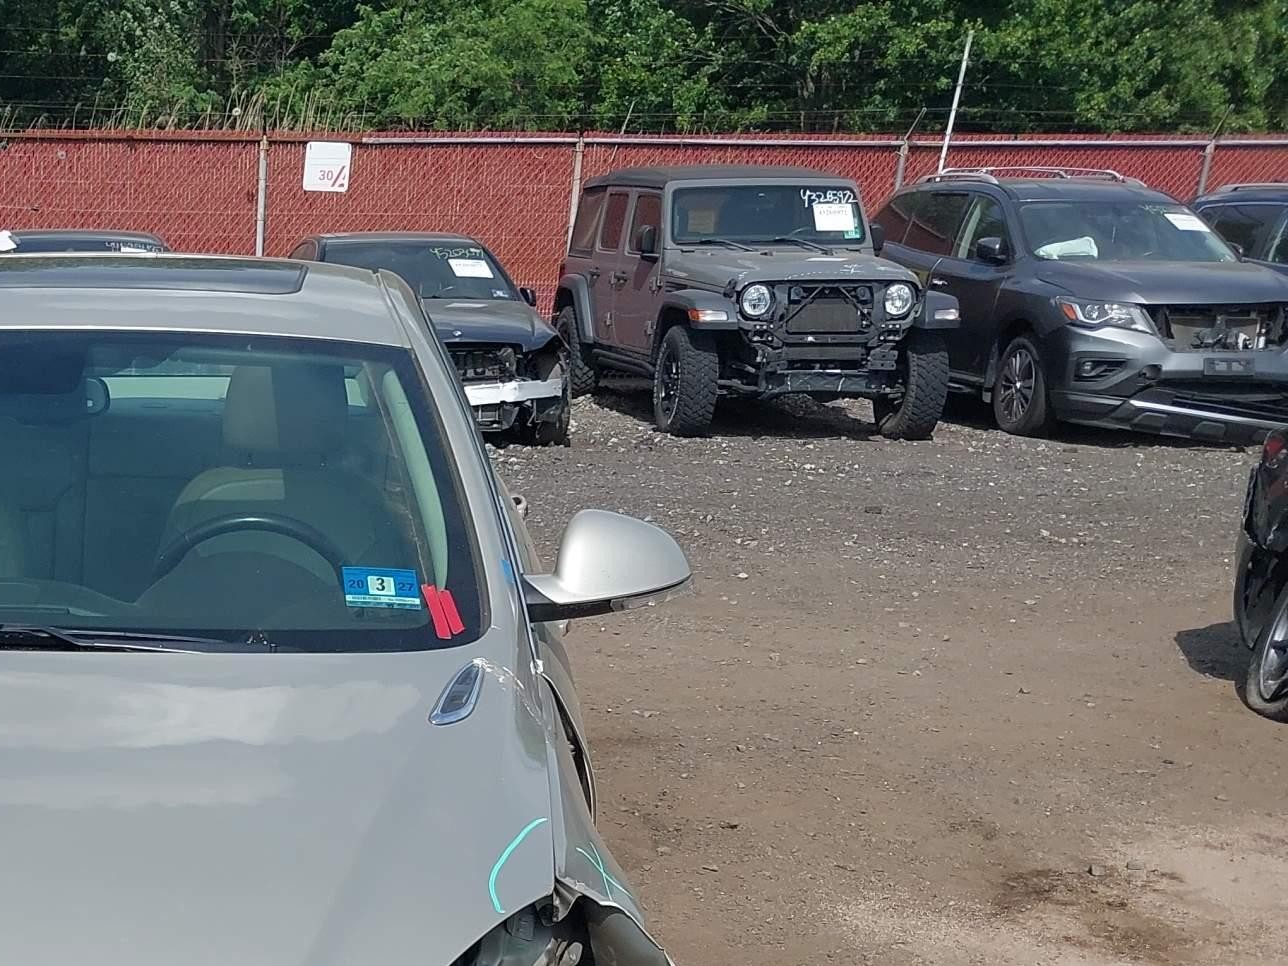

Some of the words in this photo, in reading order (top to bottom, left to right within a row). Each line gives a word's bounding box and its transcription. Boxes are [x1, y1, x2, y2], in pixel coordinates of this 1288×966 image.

[348, 579, 365, 590] 20
[375, 577, 386, 592] 3
[398, 582, 415, 592] 27
